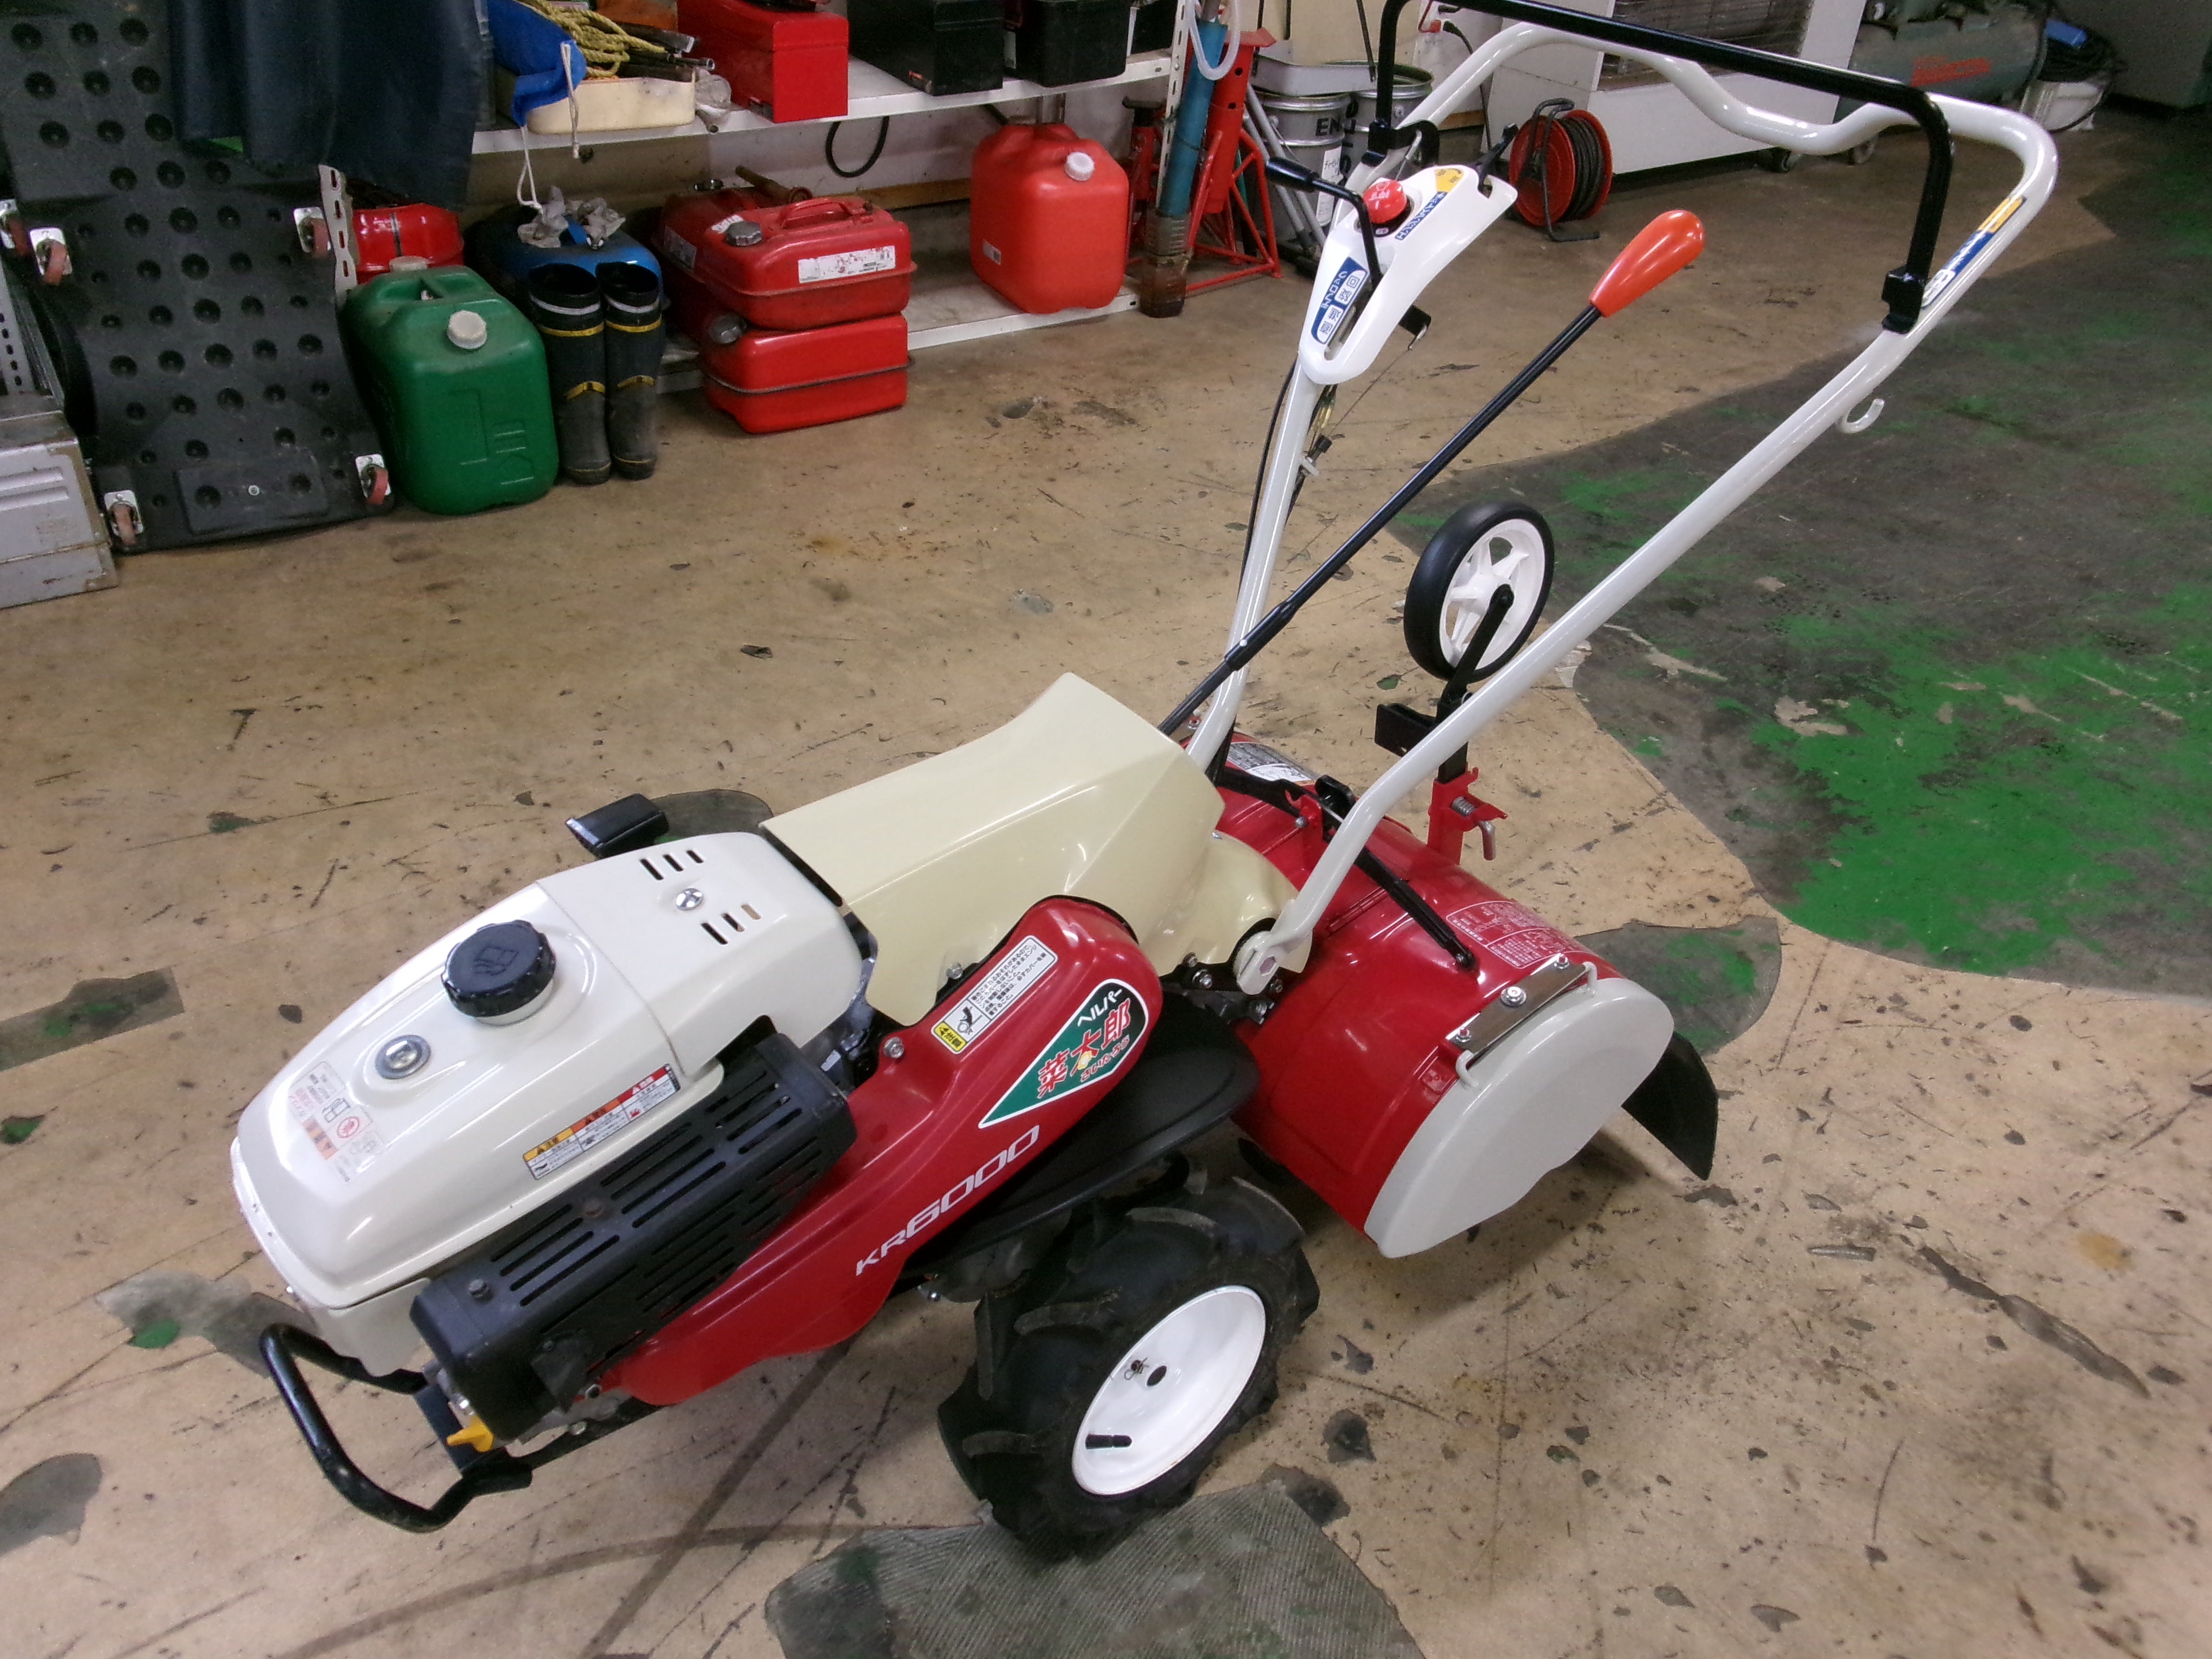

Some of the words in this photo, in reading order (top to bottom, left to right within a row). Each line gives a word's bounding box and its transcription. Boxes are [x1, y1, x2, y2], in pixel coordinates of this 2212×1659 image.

[1396, 192, 1443, 239] エンジンスイッチ
[1320, 271, 1347, 308] デフロック
[1319, 307, 1341, 334] 直進
[1078, 989, 1121, 1026] ヘルパー
[1035, 998, 1129, 1098] 菜太郎
[855, 1125, 1040, 1276] KR6000
